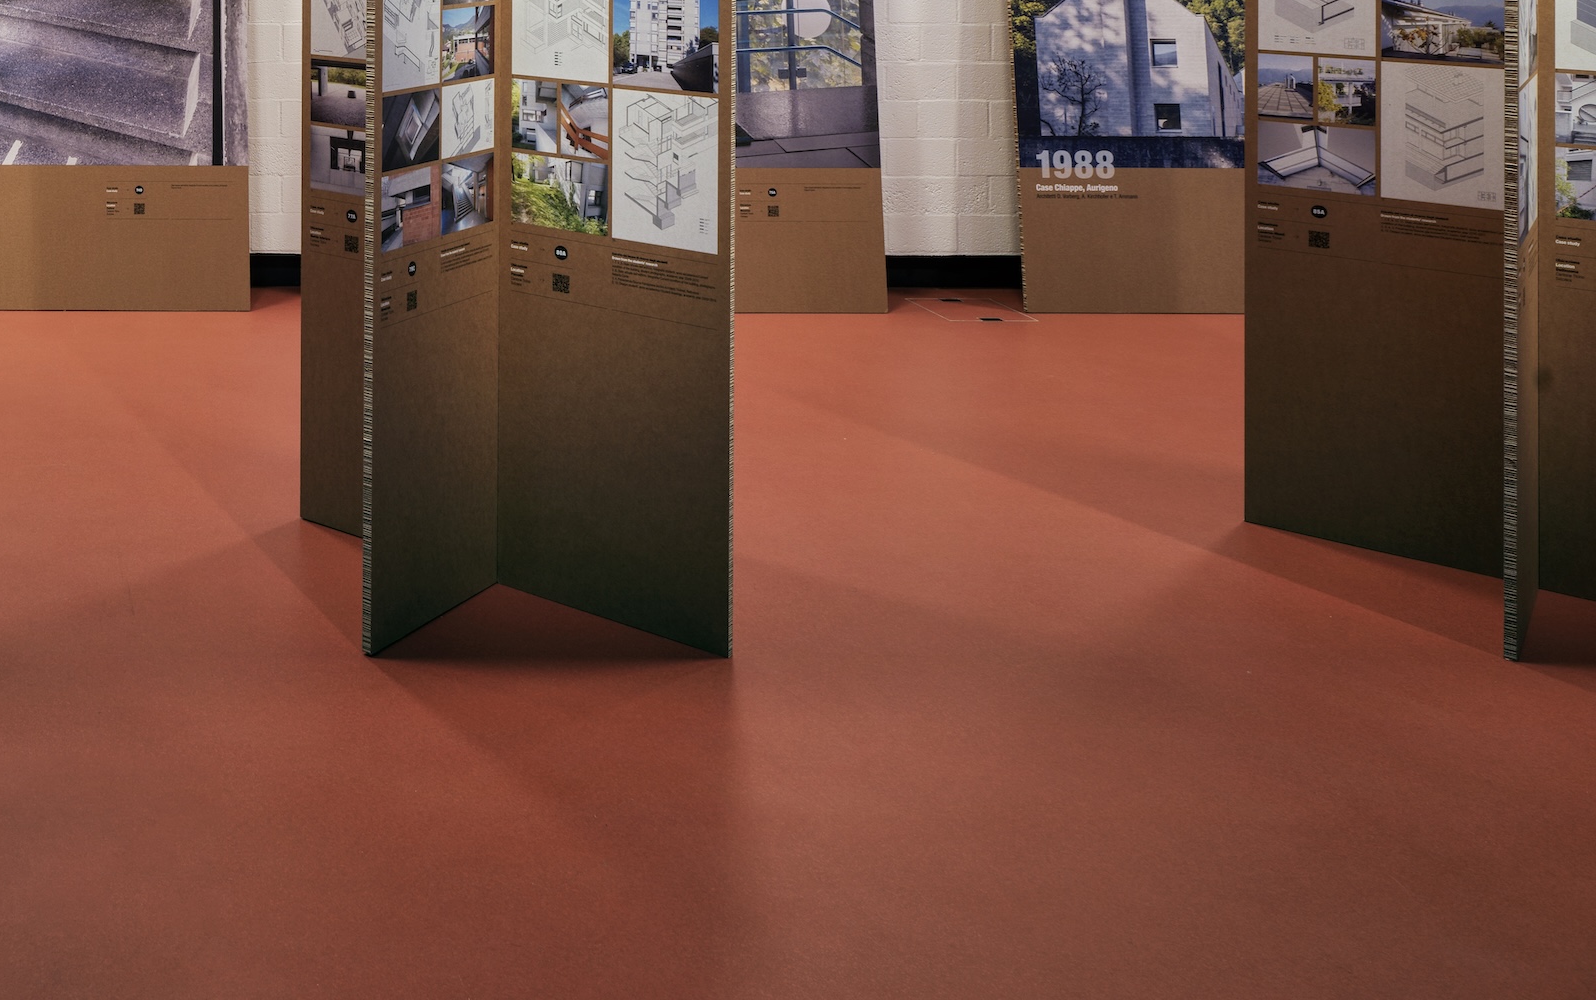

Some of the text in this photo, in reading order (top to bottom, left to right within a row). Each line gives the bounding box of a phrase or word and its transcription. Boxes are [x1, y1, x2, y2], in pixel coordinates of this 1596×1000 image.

[1036, 149, 1115, 179] 1988
[1036, 183, 1118, 193] Case Chiappe, Aurigeno
